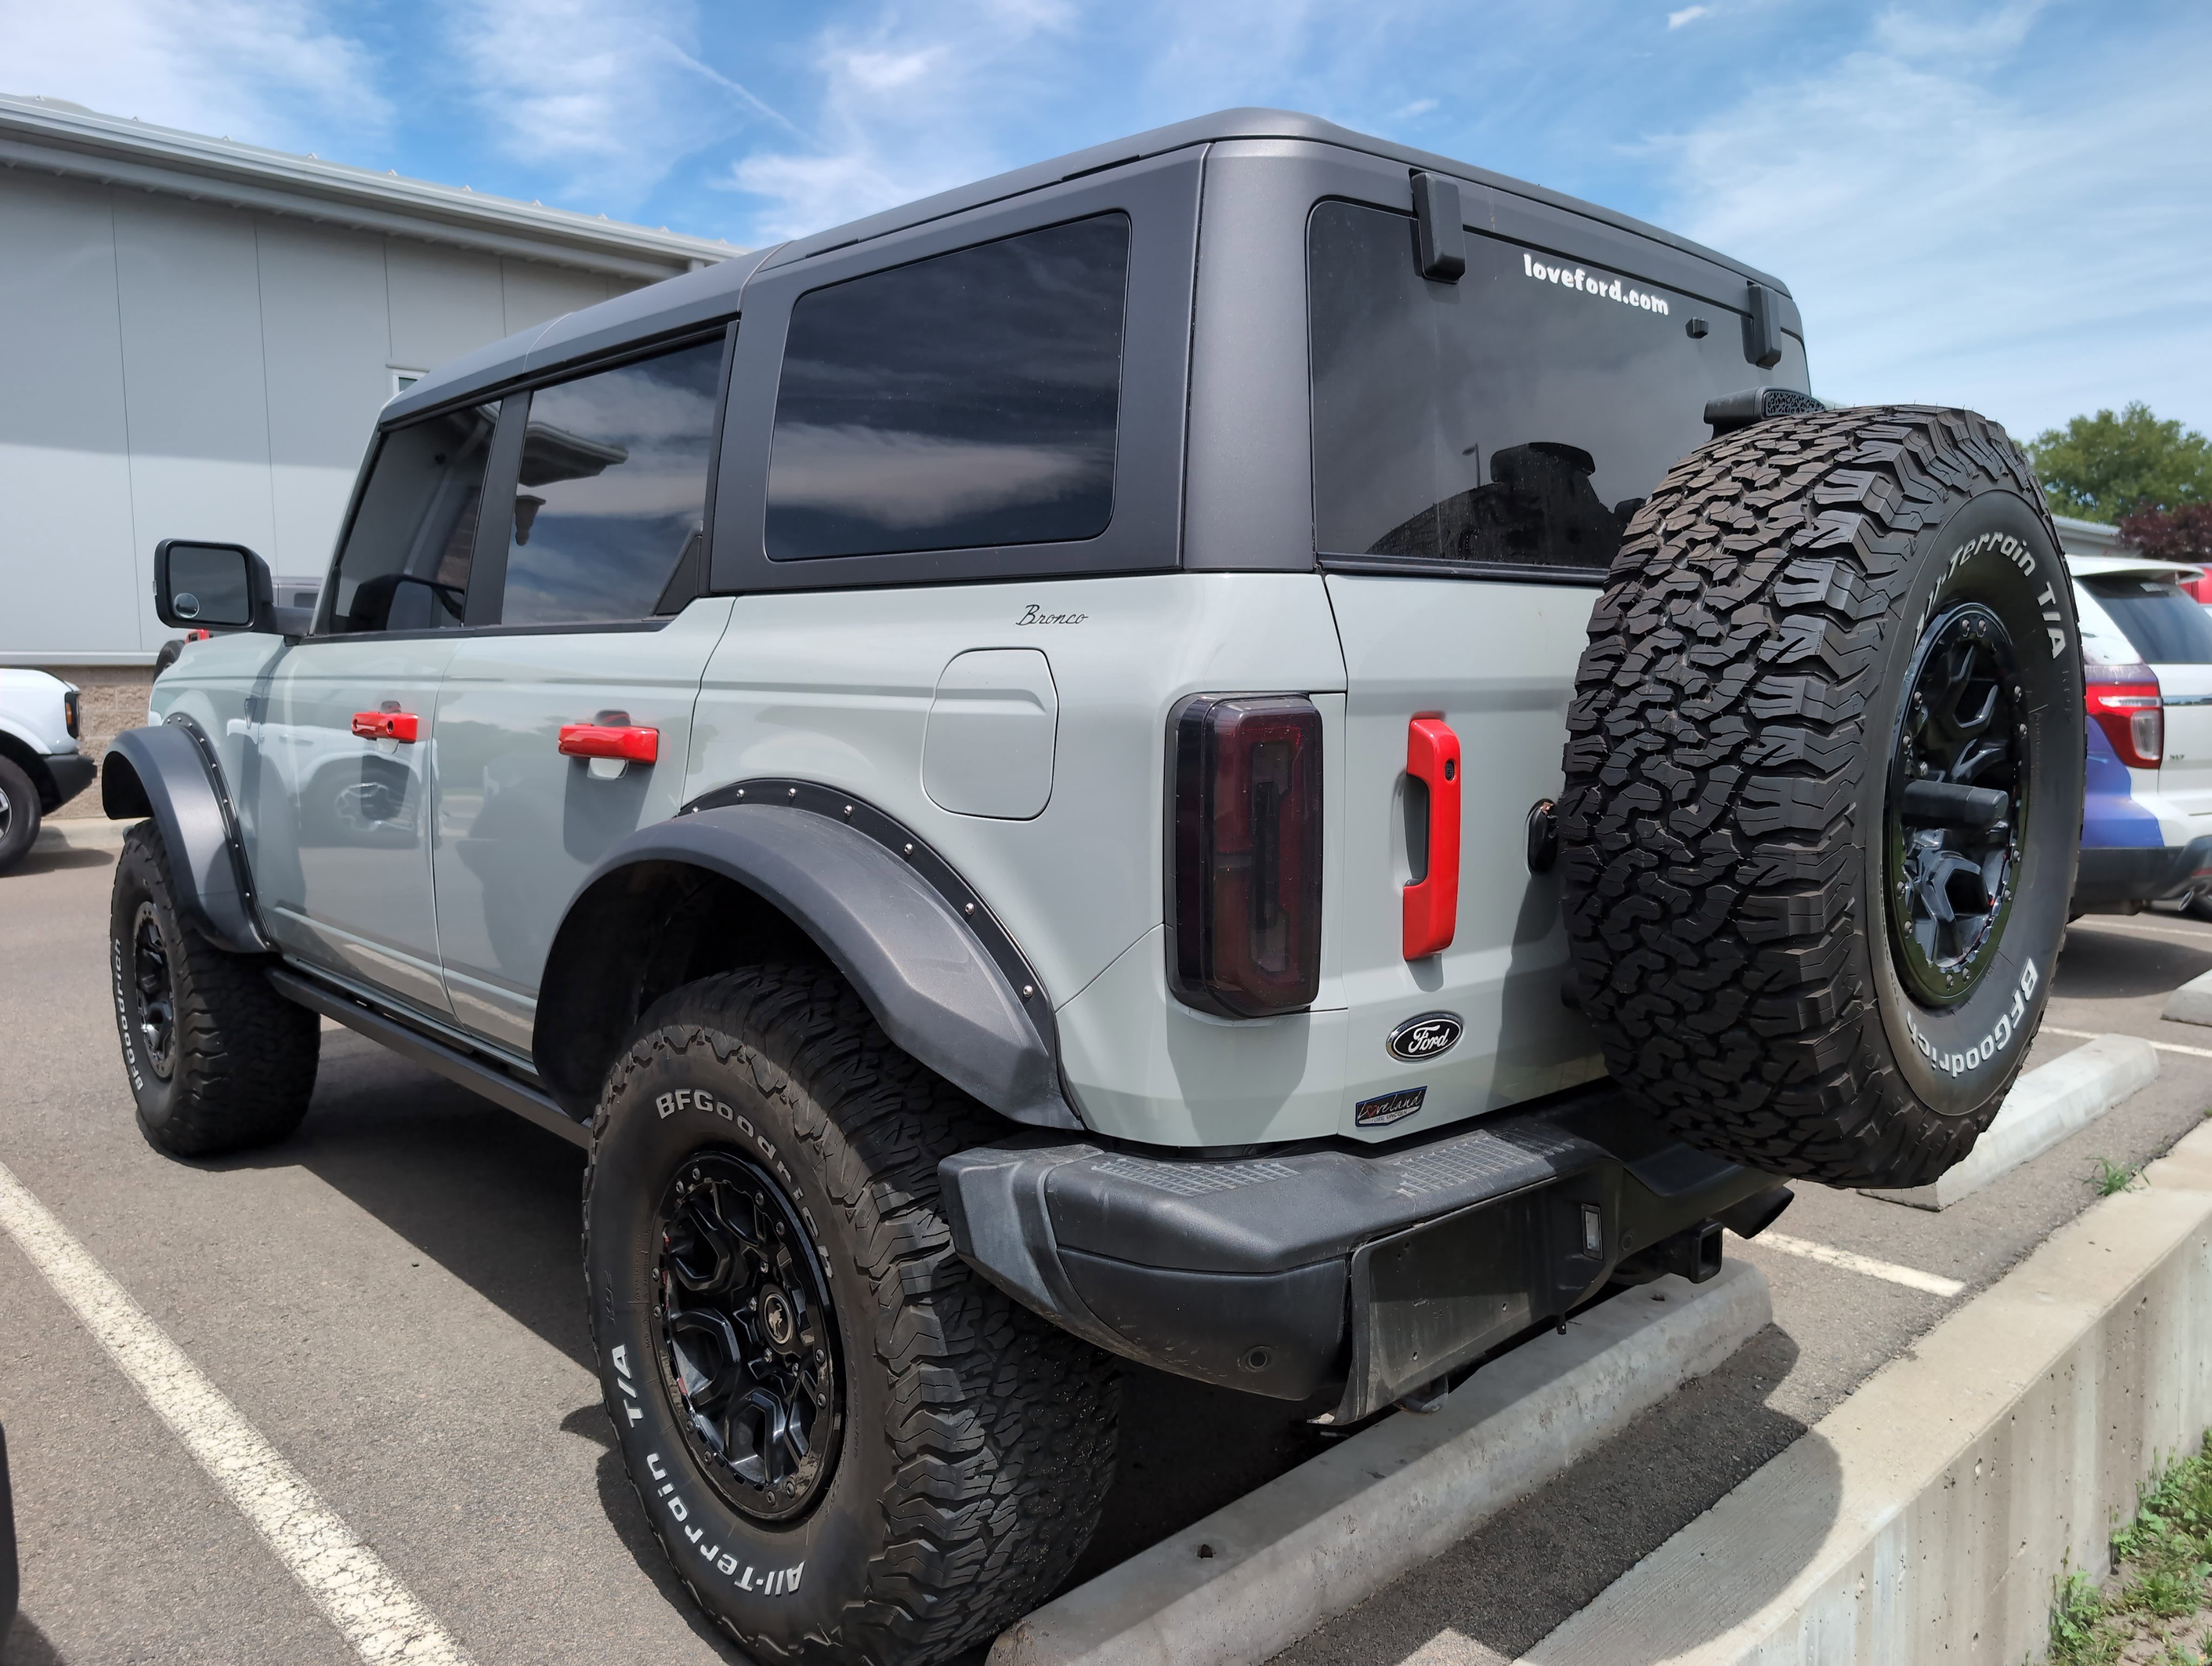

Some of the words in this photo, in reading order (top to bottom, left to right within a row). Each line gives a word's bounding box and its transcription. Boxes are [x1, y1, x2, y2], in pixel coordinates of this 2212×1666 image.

[1523, 253, 1669, 316] loveford.com
[1015, 604, 1089, 626] Bronco
[2037, 581, 2067, 659] T/A
[114, 938, 144, 1092] BFGoodrich
[1408, 1024, 1450, 1053] Ford
[1906, 958, 2039, 1078] BFGoodrich
[1386, 1110, 1408, 1119] LINCOLN
[655, 1088, 834, 1278] BFGoodrich
[612, 1344, 644, 1429] T/A
[647, 1452, 806, 1596] All-Terrain
